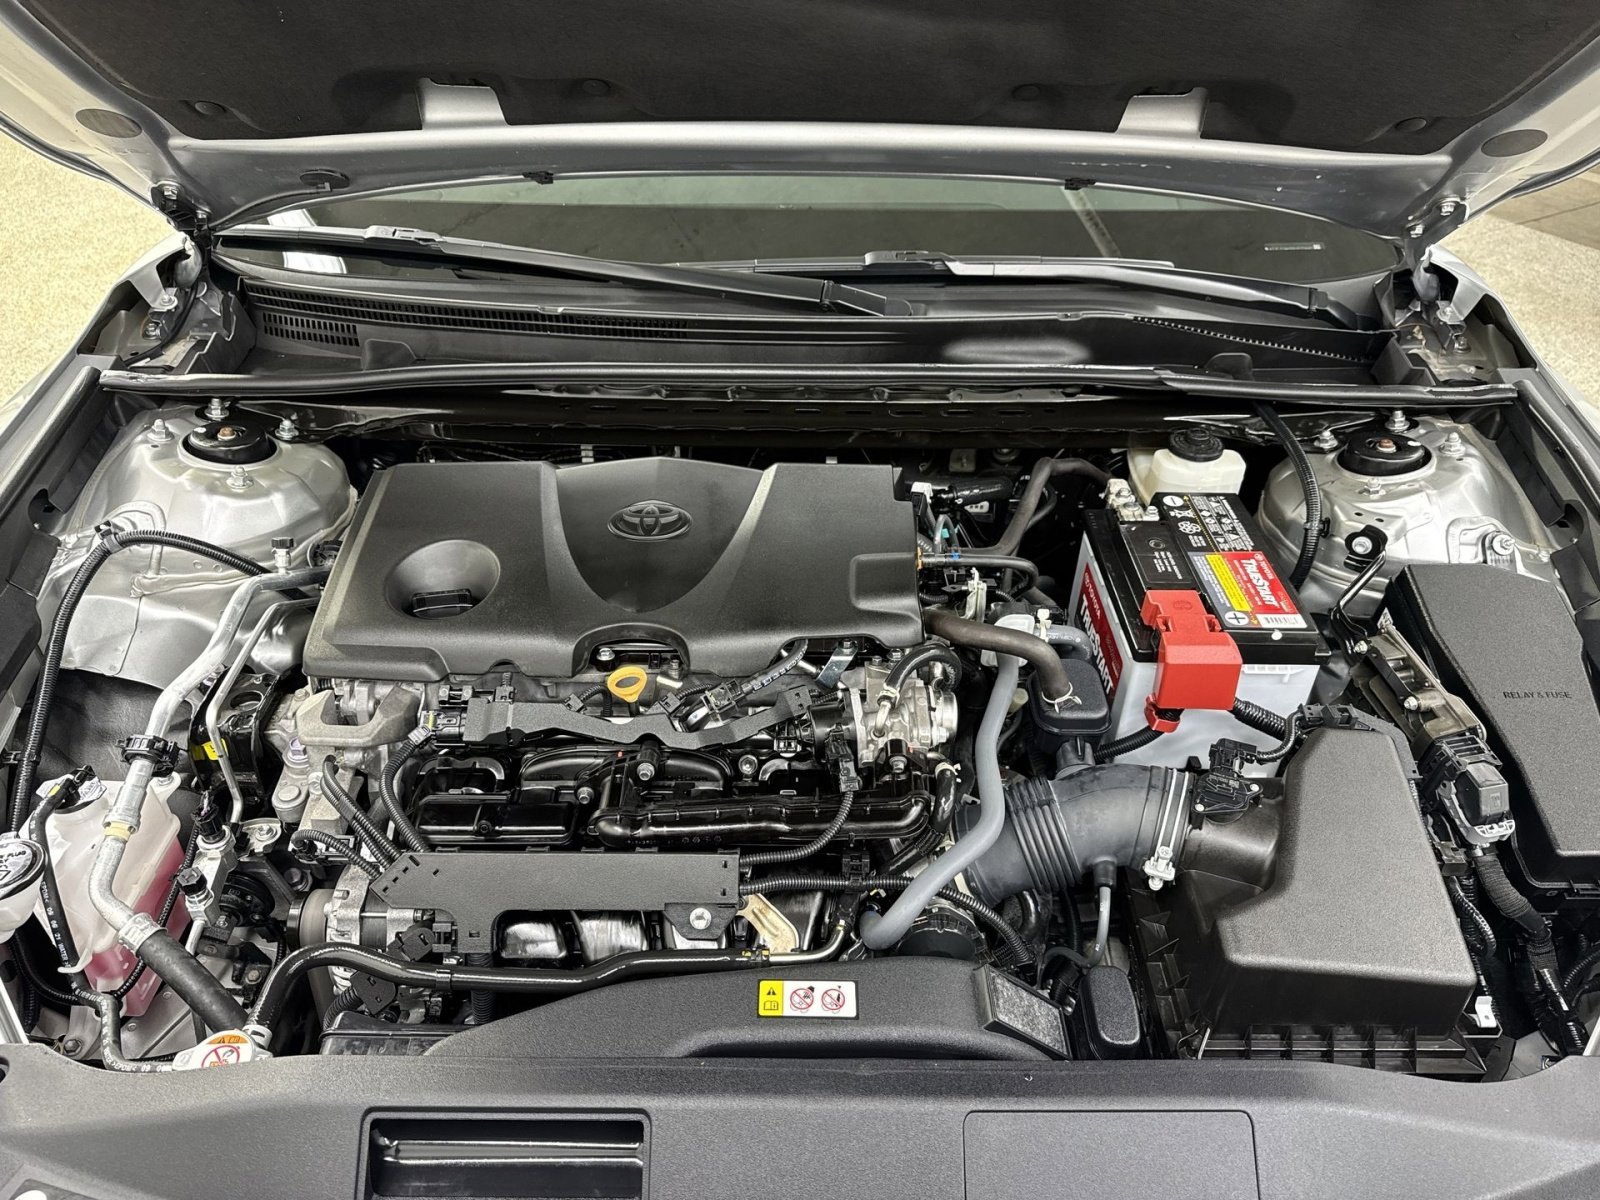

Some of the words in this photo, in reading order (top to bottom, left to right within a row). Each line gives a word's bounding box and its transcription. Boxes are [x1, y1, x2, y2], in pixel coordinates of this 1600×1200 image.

[1260, 560, 1275, 580] TOYOTA
[1502, 691, 1534, 699] RELAY
[1545, 691, 1573, 699] FUSE
